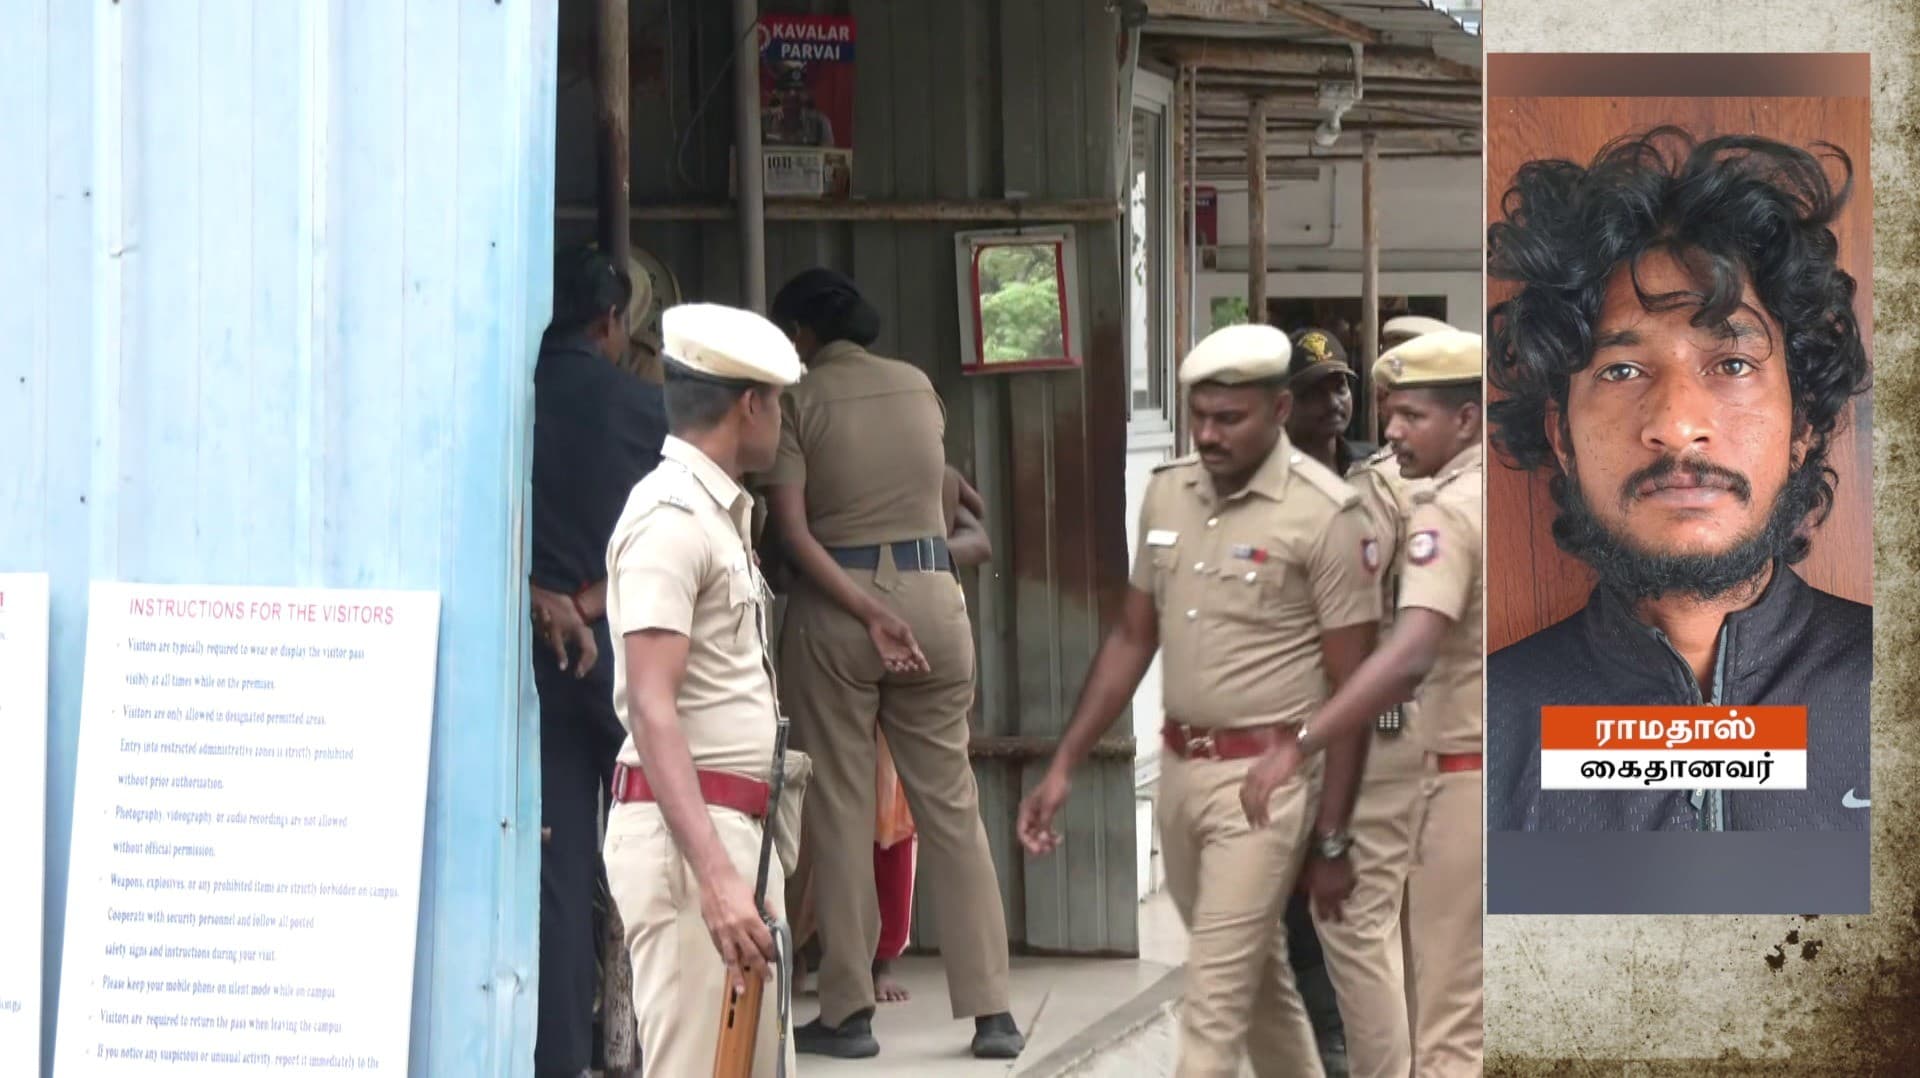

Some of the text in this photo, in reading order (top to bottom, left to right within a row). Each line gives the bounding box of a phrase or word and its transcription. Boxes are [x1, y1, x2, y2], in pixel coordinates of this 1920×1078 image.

[773, 24, 850, 41] KAVALAR
[781, 43, 840, 60] PARVAI
[129, 597, 394, 625] INSTRUCTIONS FOR THE VISITORS
[128, 636, 157, 653] Visitors
[159, 641, 171, 653] are
[172, 640, 204, 656] typically
[206, 642, 239, 657] required
[240, 643, 248, 655] to
[250, 645, 268, 656] wear
[270, 645, 278, 655] or
[279, 643, 306, 660] display
[308, 645, 320, 657] the
[151, 673, 159, 686] at
[172, 673, 192, 687] times
[194, 673, 214, 688] while
[216, 677, 225, 688] on
[227, 676, 239, 689] the
[123, 703, 152, 720] Visitors
[153, 709, 165, 720] are
[166, 707, 182, 722] only
[184, 707, 214, 722] allowed
[216, 711, 223, 722] in
[225, 709, 265, 727] designated
[266, 711, 304, 726] permitted
[120, 737, 141, 756] Entry
[143, 741, 158, 753] into
[160, 741, 197, 756] restricted
[198, 743, 253, 757] administrative
[285, 745, 311, 760] strictly
[118, 772, 148, 786] without
[149, 775, 169, 790] prior
[216, 813, 224, 824] or
[226, 810, 247, 825] audio
[249, 812, 288, 829] recordings
[290, 815, 301, 826] are
[303, 815, 316, 827] not
[113, 840, 143, 855] without
[145, 840, 172, 856] official
[188, 879, 196, 890] or
[198, 879, 211, 893] any
[213, 878, 253, 895] prohibited
[276, 882, 288, 893] are
[290, 881, 317, 896] strictly
[358, 886, 368, 897] on
[107, 905, 144, 925] Cooperate
[147, 909, 164, 923] with
[167, 911, 196, 927] security
[198, 912, 235, 928] personnel
[236, 914, 251, 926] and
[278, 914, 288, 928] all
[129, 944, 147, 959] signs
[149, 944, 163, 957] and
[164, 944, 210, 959] instructions
[211, 946, 237, 964] during
[239, 949, 256, 964] your
[102, 973, 125, 990] Please
[126, 976, 145, 994] keep
[147, 979, 164, 995] your
[166, 978, 191, 993] mobile
[192, 979, 215, 996] phone
[217, 983, 226, 994] on
[251, 981, 271, 996] mode
[272, 982, 294, 998] while
[295, 986, 305, 998] on
[100, 1007, 129, 1024] Visitors
[131, 1012, 142, 1025] are
[146, 1012, 179, 1030] required
[180, 1013, 188, 1026] to
[190, 1014, 214, 1028] return
[216, 1015, 228, 1029] the
[248, 1017, 269, 1031] when
[270, 1016, 297, 1035] leaving
[299, 1018, 312, 1032] the
[105, 1047, 119, 1062] you
[120, 1046, 143, 1060] notice
[144, 1048, 158, 1063] any
[160, 1047, 198, 1064] suspicious
[199, 1050, 209, 1062] or
[274, 1054, 299, 1068] report
[309, 1053, 354, 1071] immediately
[357, 1055, 366, 1069] to
[367, 1055, 380, 1070] the
